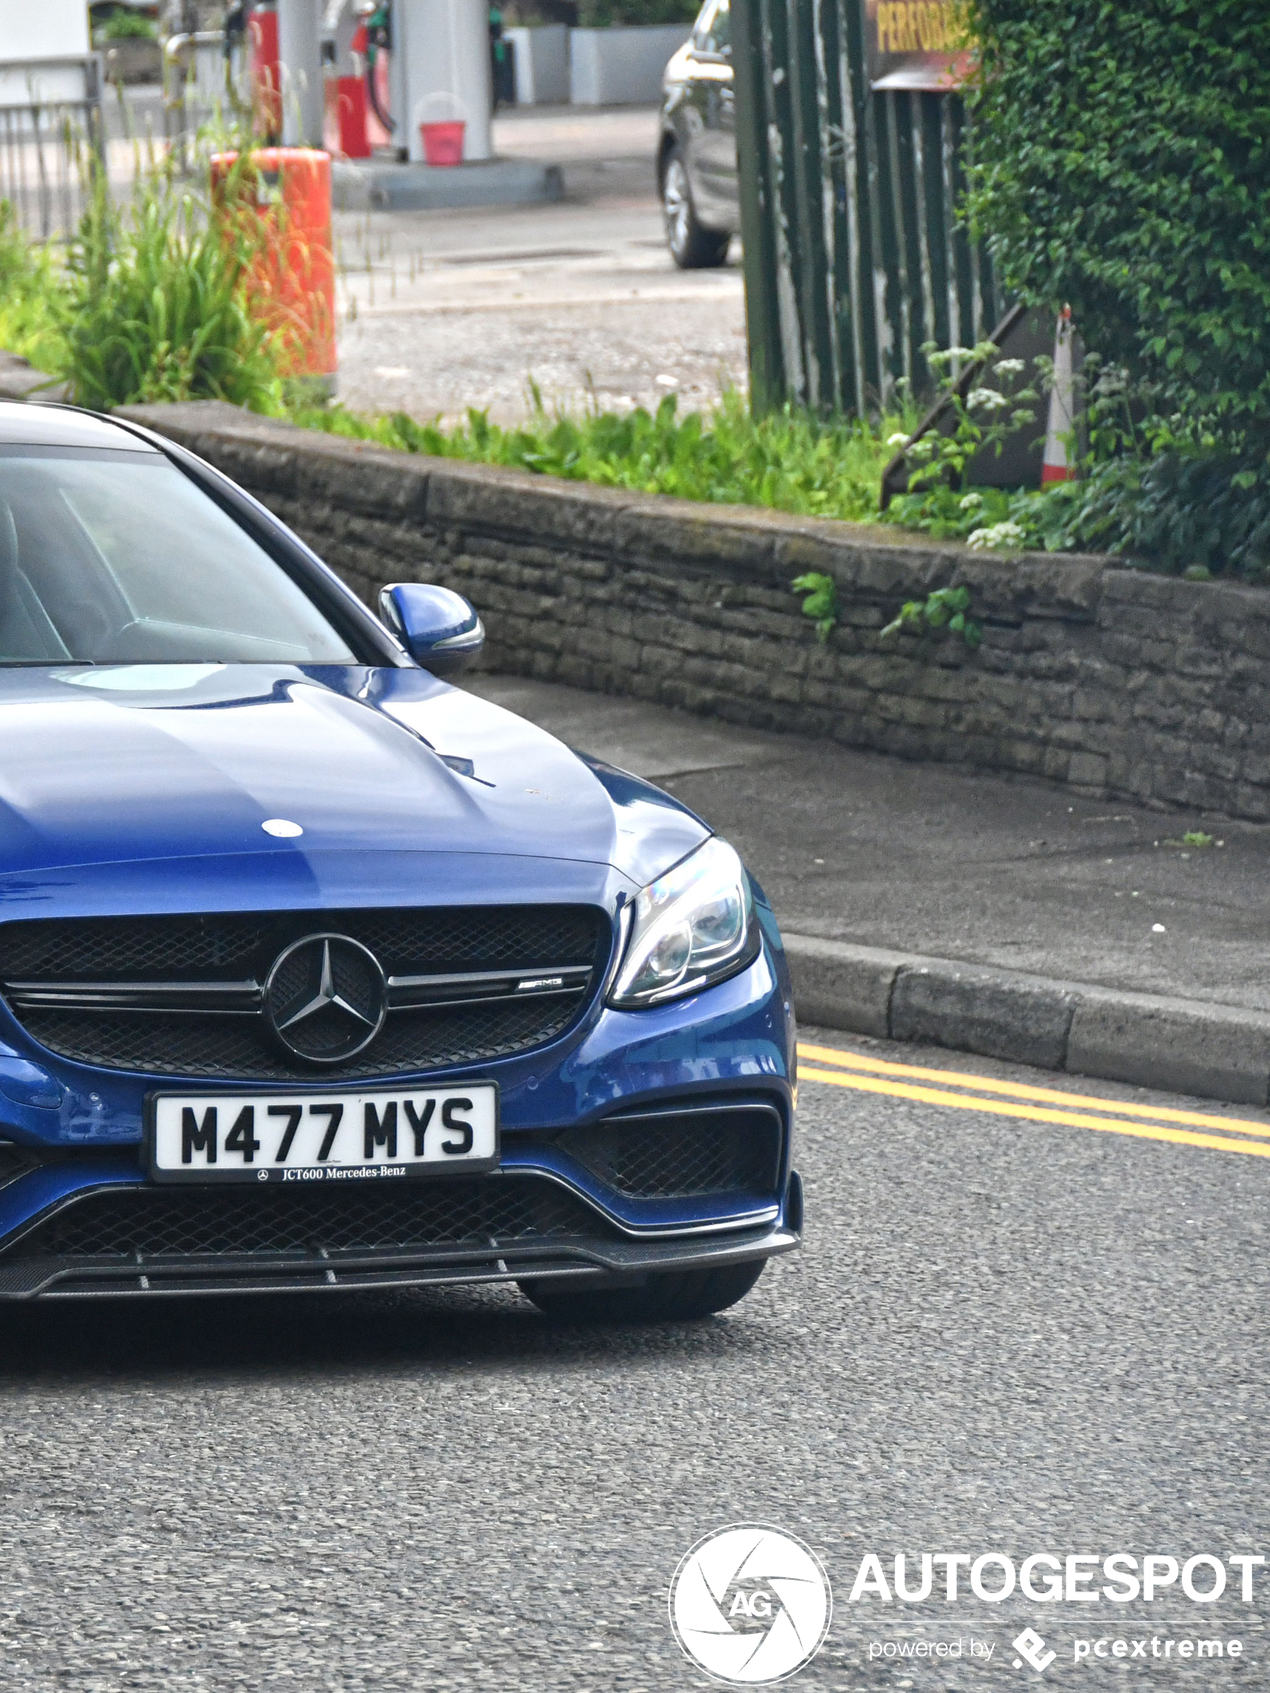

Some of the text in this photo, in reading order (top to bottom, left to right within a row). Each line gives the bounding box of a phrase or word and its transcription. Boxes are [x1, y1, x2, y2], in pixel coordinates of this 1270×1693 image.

[525, 977, 562, 987] AMG
[182, 1097, 474, 1164] M477 MYS
[282, 1166, 407, 1181] JCT600 Mercedes-Benz
